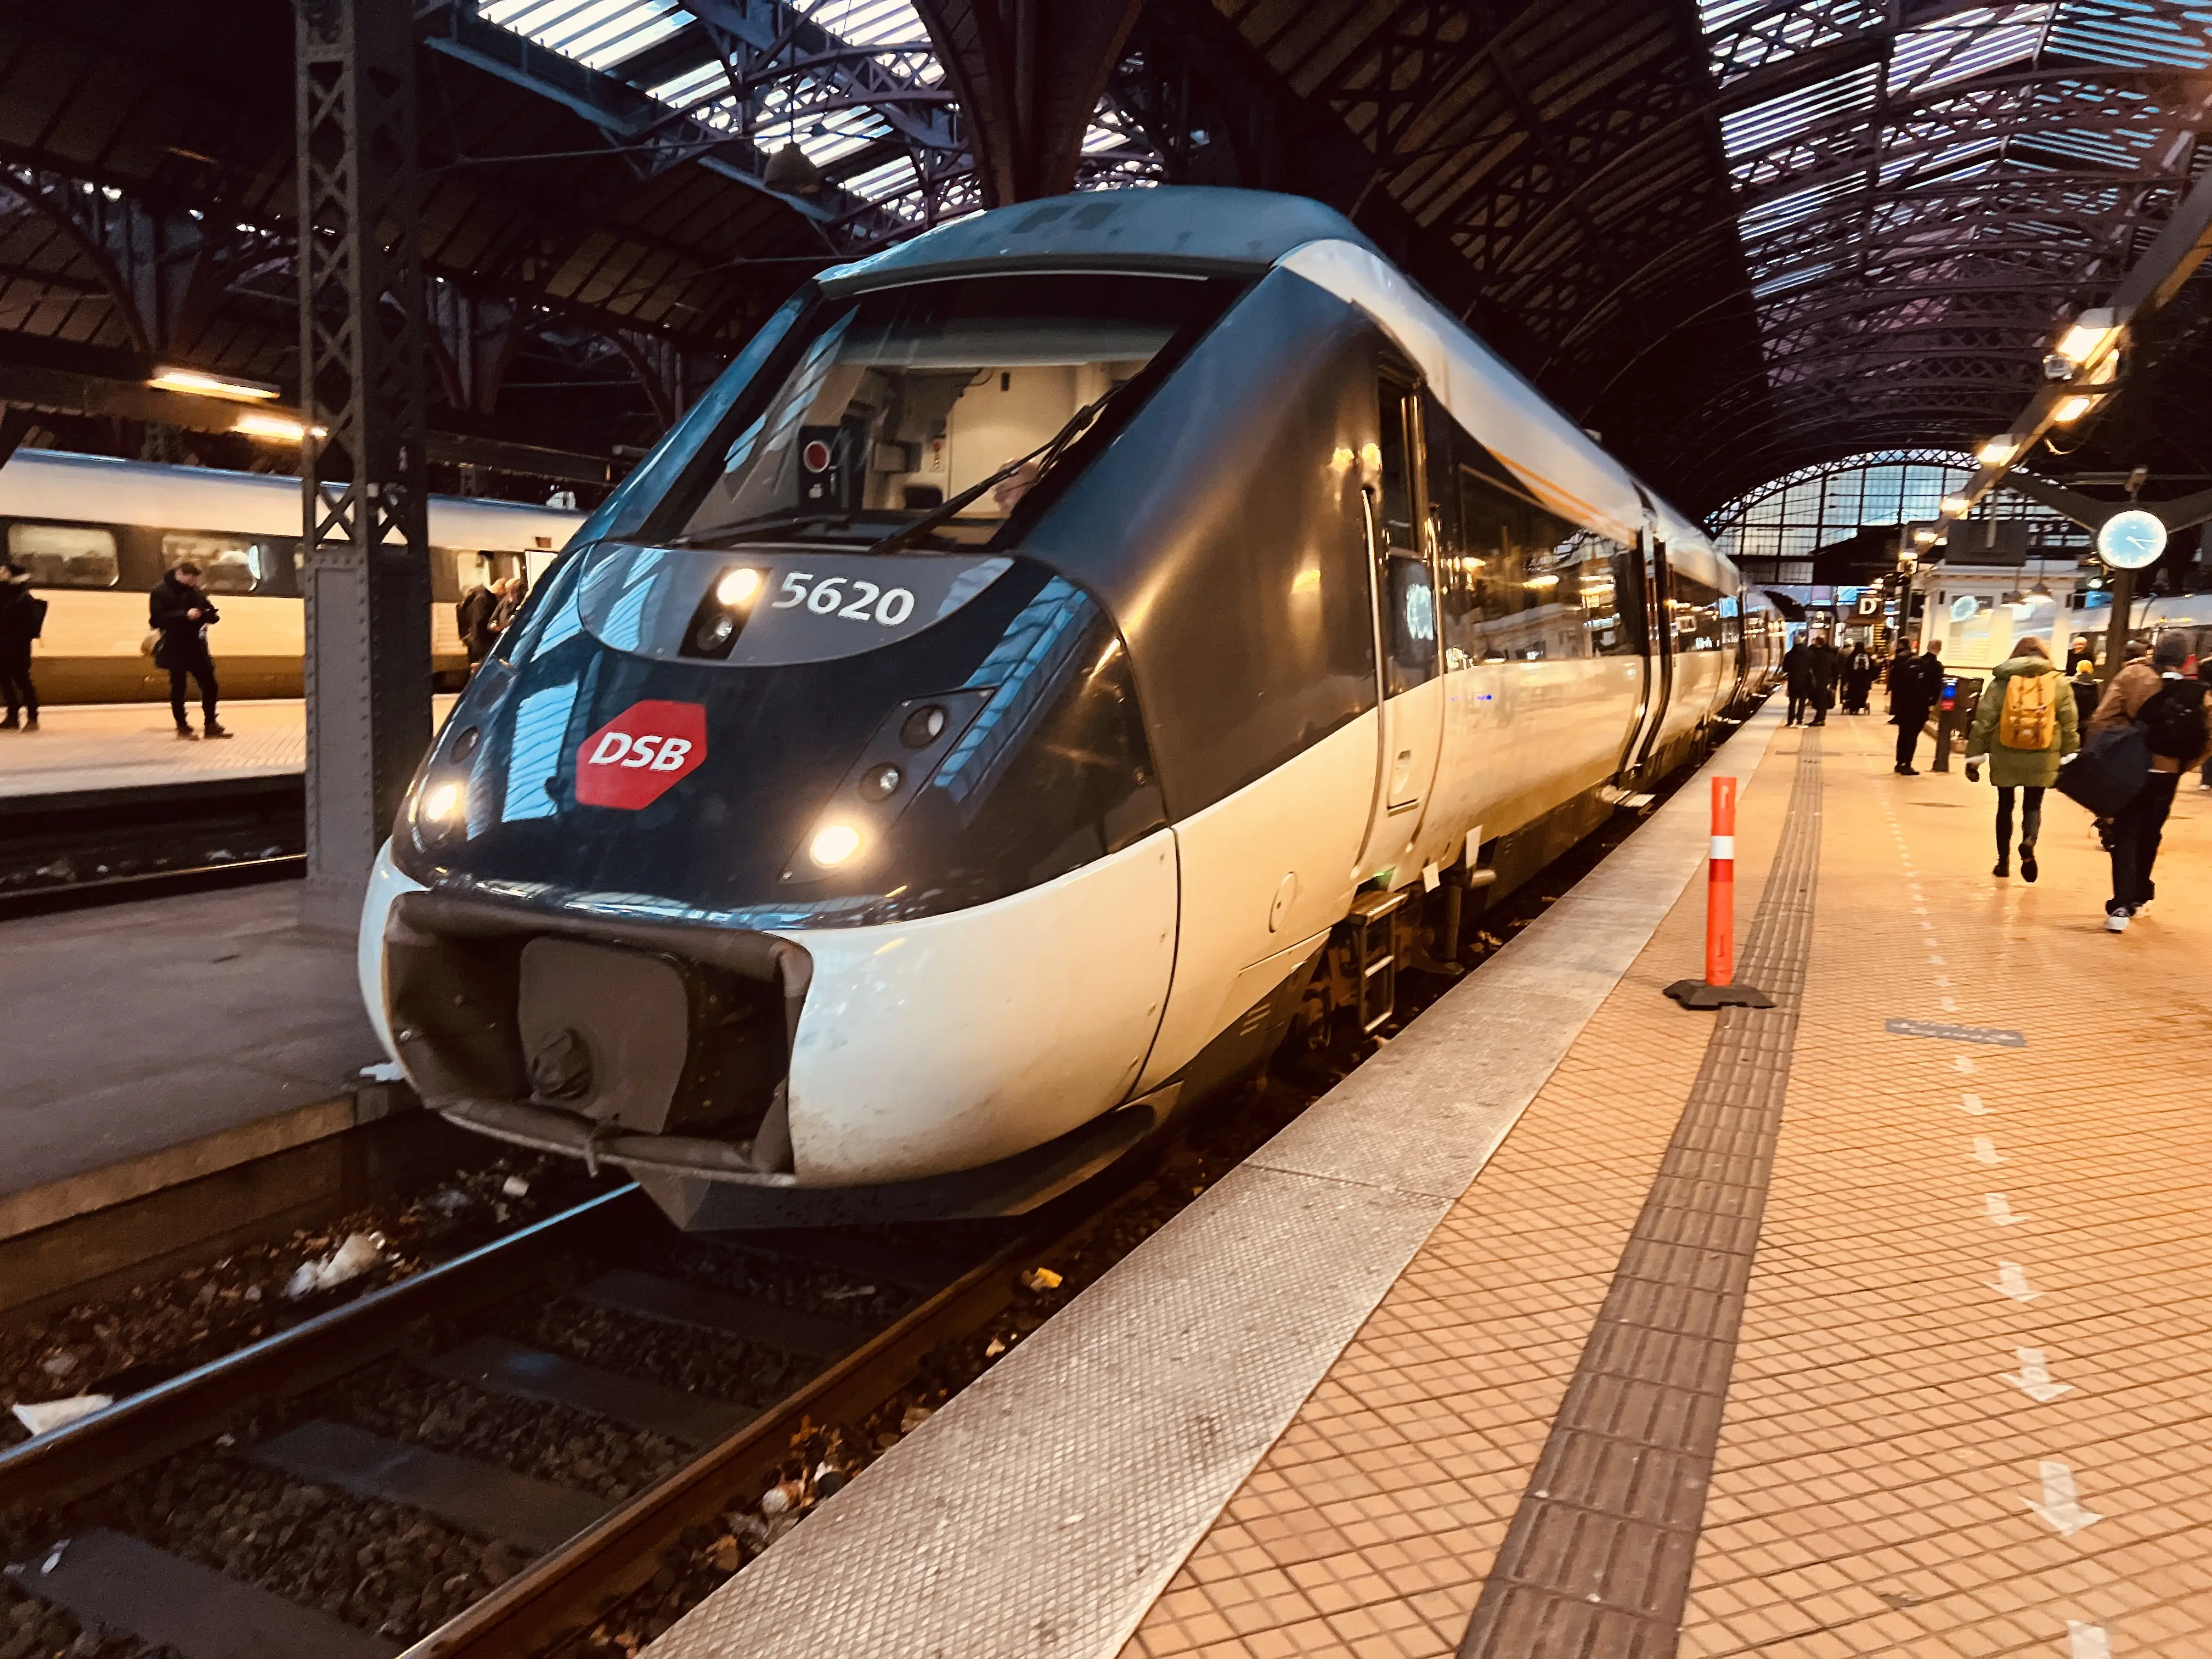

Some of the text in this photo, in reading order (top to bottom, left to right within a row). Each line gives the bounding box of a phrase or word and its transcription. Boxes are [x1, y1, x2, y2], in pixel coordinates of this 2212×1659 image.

[772, 572, 915, 626] 5620
[1859, 597, 1877, 614] D
[588, 732, 692, 771] DSB
